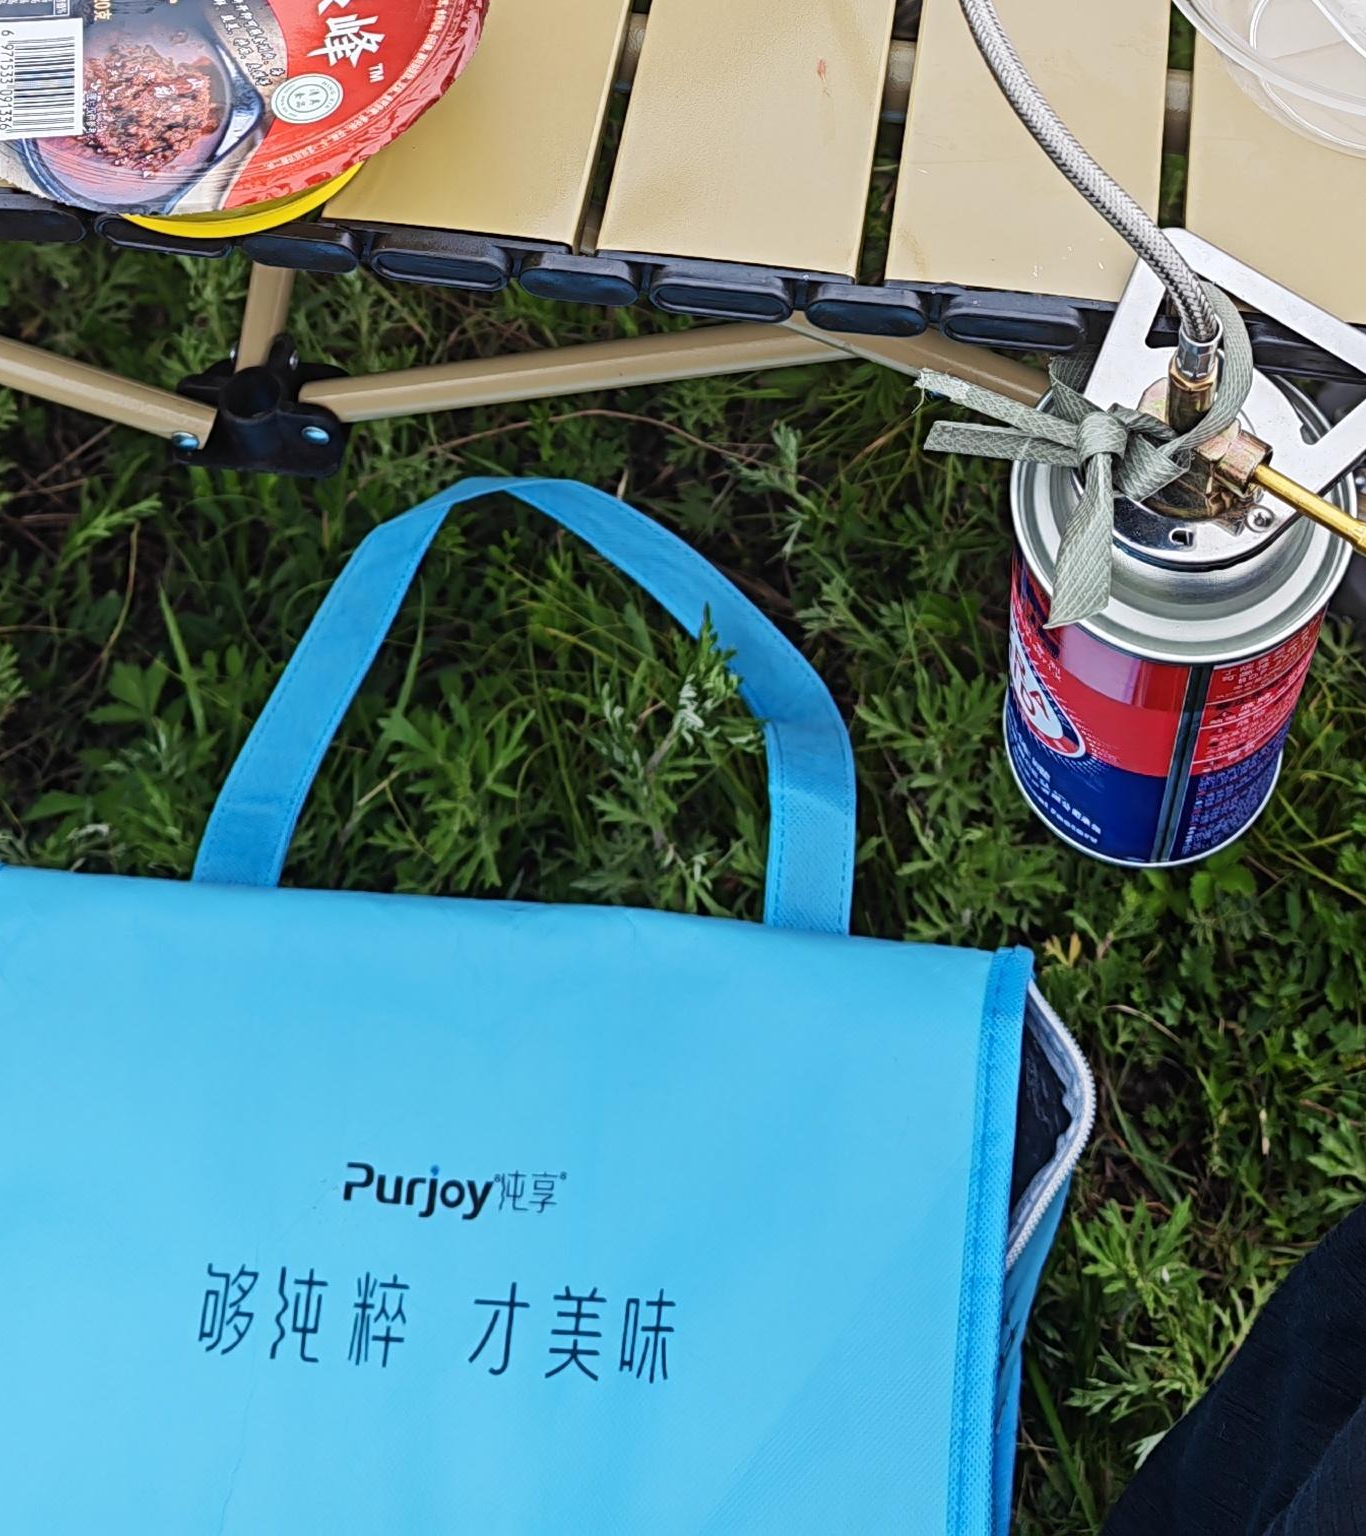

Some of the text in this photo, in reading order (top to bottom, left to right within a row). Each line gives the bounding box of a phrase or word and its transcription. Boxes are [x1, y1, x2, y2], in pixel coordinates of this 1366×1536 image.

[0, 44, 15, 84] 971533
[369, 63, 385, 82] TM
[343, 1162, 494, 1220] Purjoy
[468, 1282, 676, 1384] 才美味
